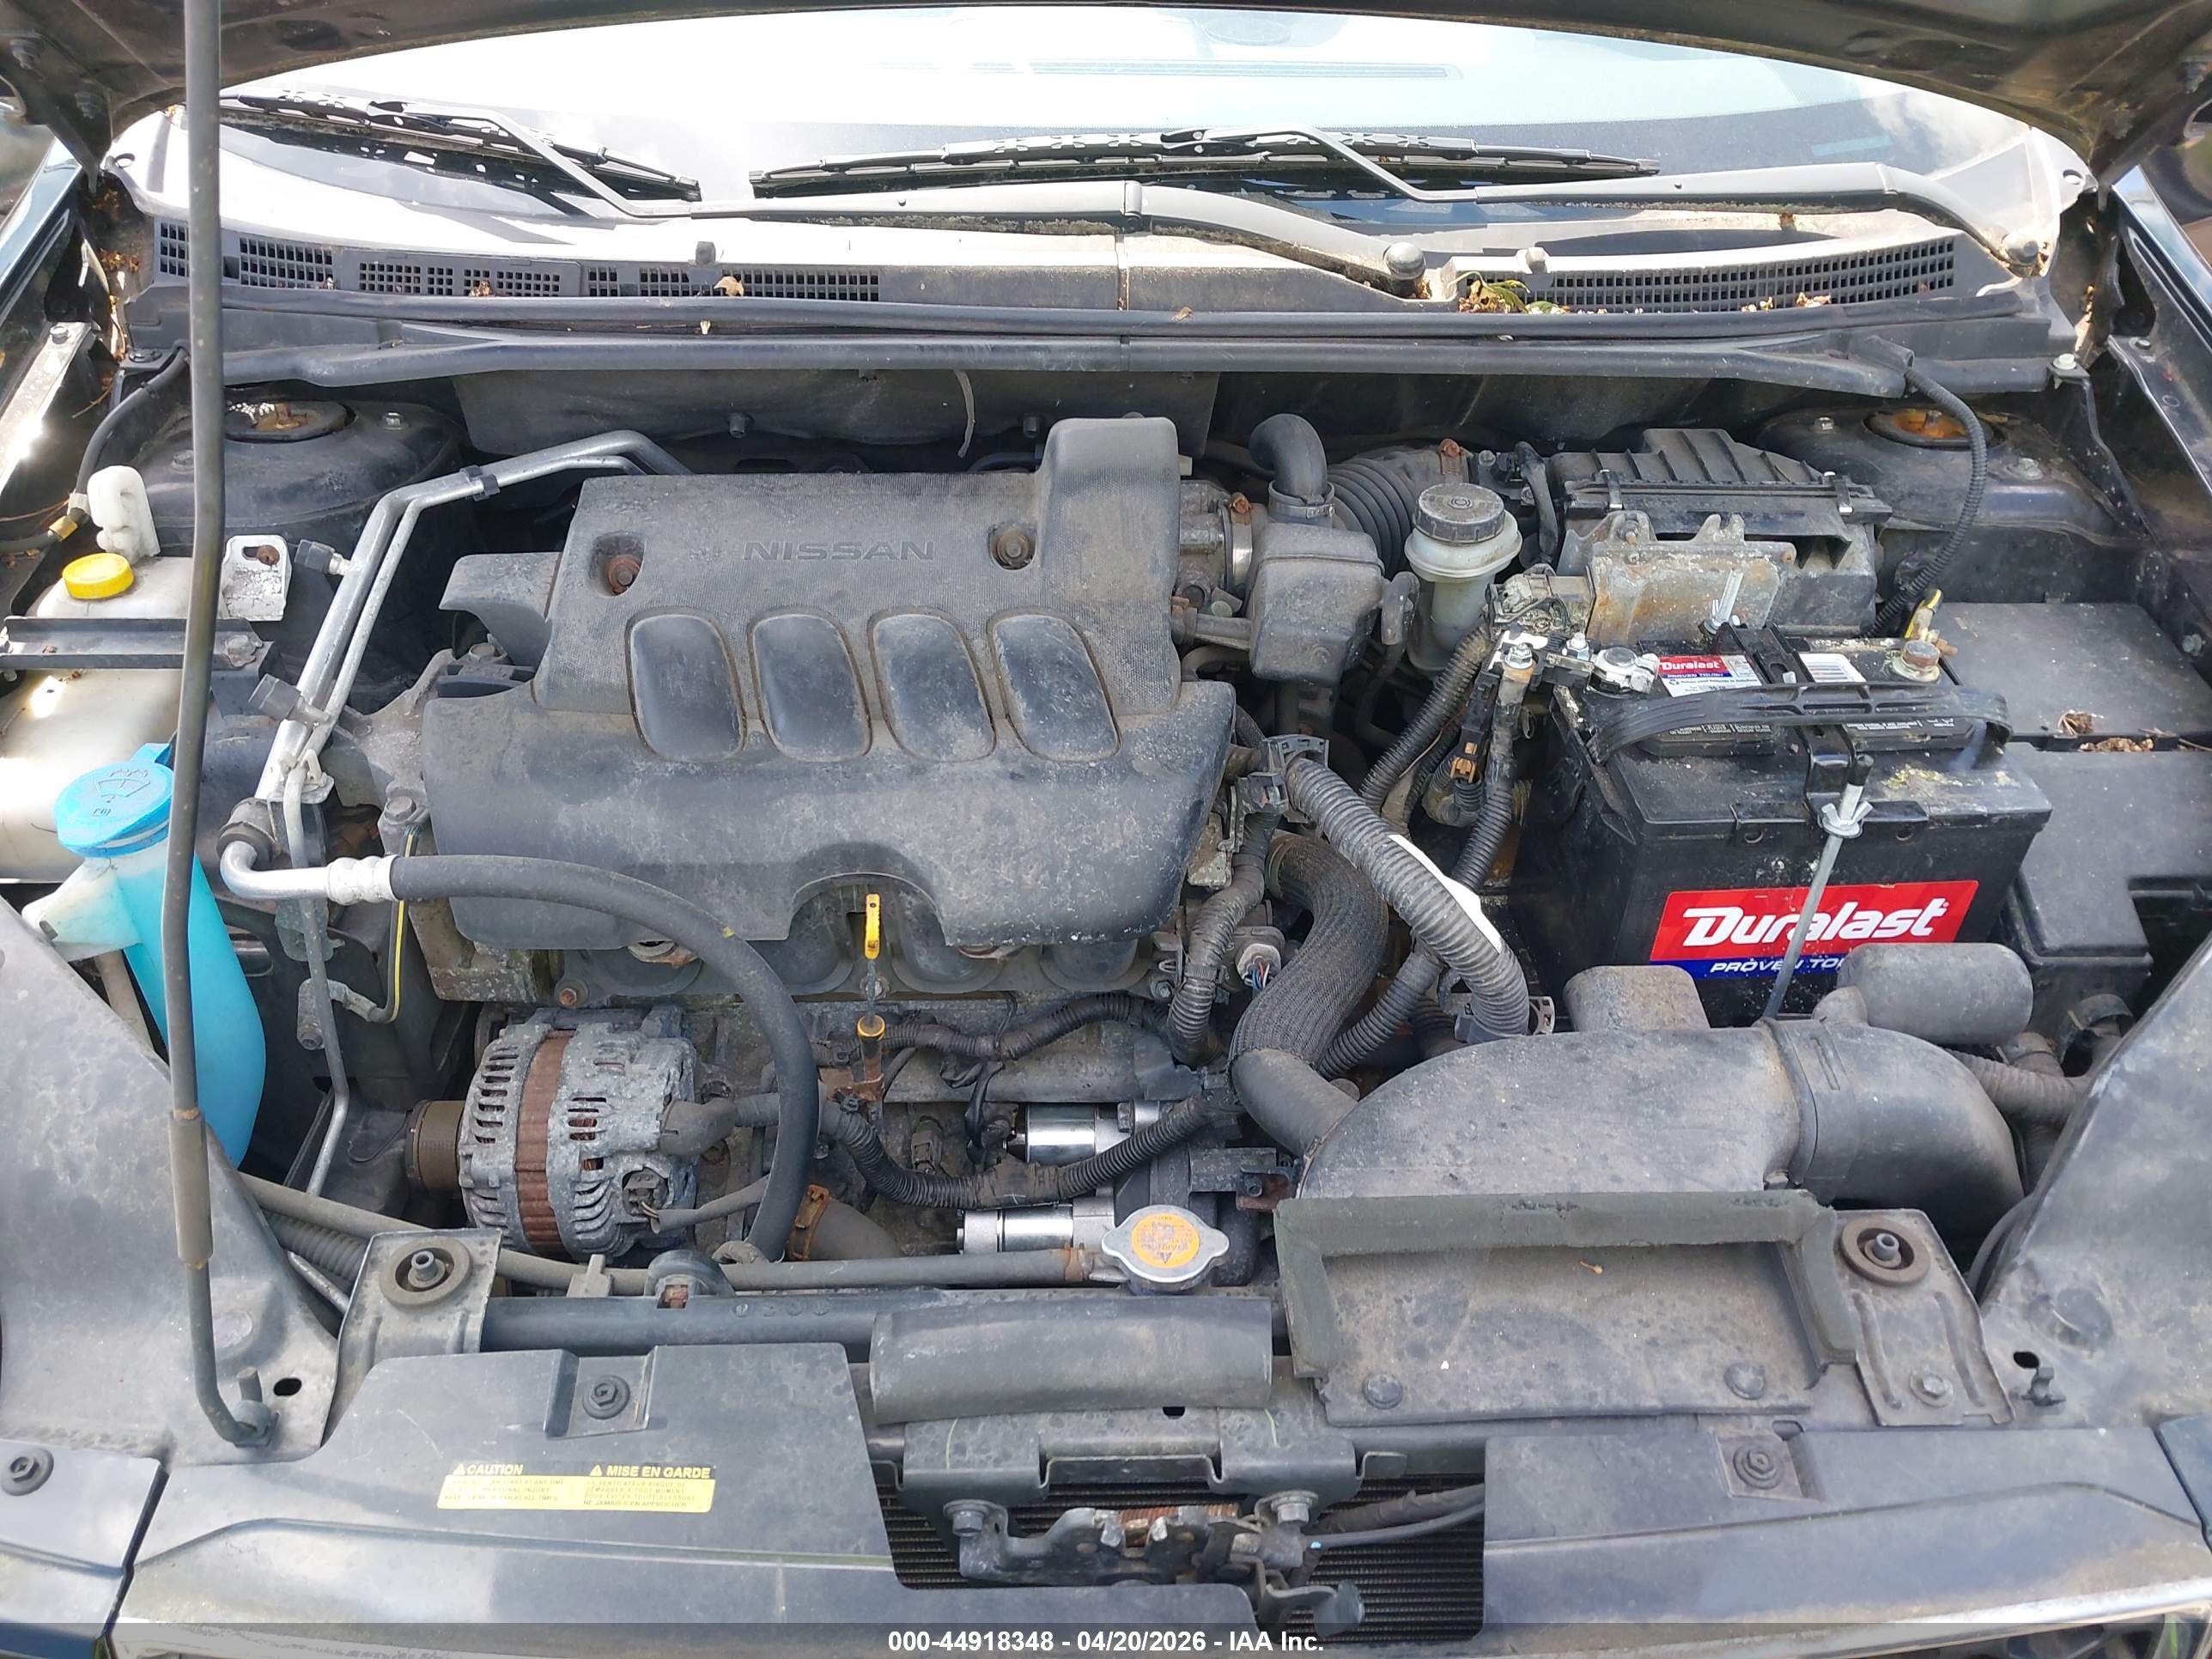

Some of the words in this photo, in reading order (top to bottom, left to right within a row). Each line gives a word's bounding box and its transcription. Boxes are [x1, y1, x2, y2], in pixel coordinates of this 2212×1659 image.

[743, 541, 934, 561] NISSAN
[1658, 660, 1721, 671] Duralast
[1682, 897, 1949, 947] Duralast
[465, 1464, 524, 1476] CAUTION
[606, 1465, 640, 1477] MISE
[641, 1466, 661, 1478] EN
[663, 1467, 711, 1479] GARDE
